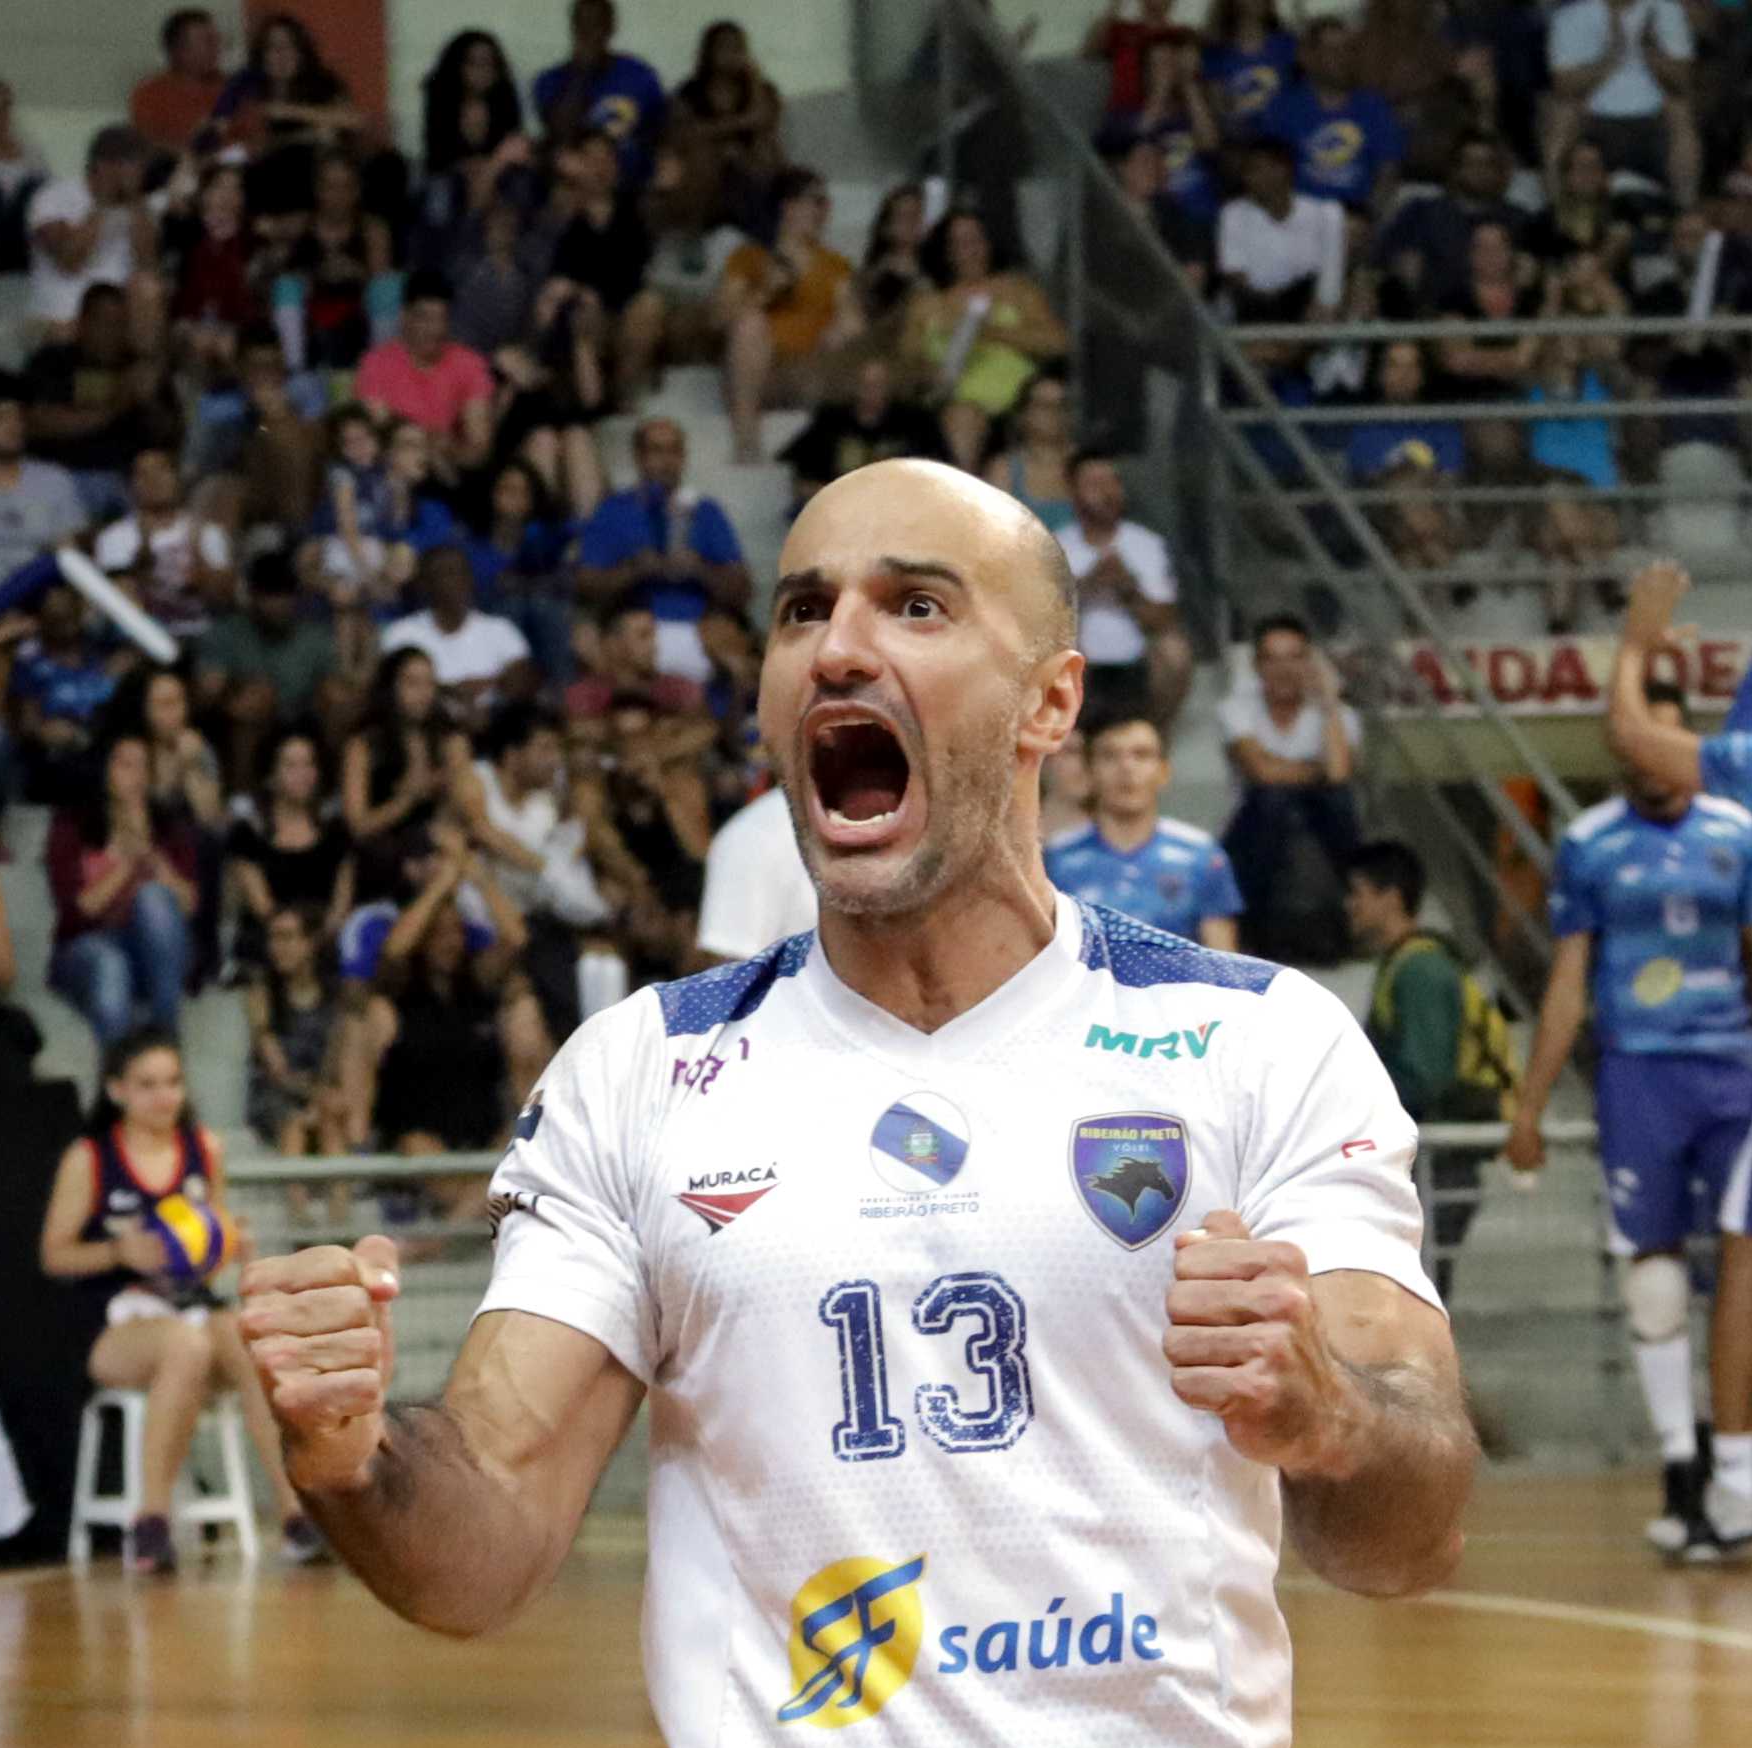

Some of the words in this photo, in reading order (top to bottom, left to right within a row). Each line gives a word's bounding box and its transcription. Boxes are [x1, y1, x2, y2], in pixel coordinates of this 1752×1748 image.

[1084, 1020, 1223, 1060] MRV
[930, 1201, 979, 1215] PRETO
[818, 1271, 1035, 1461] 13
[938, 1592, 1165, 1674] saúde
